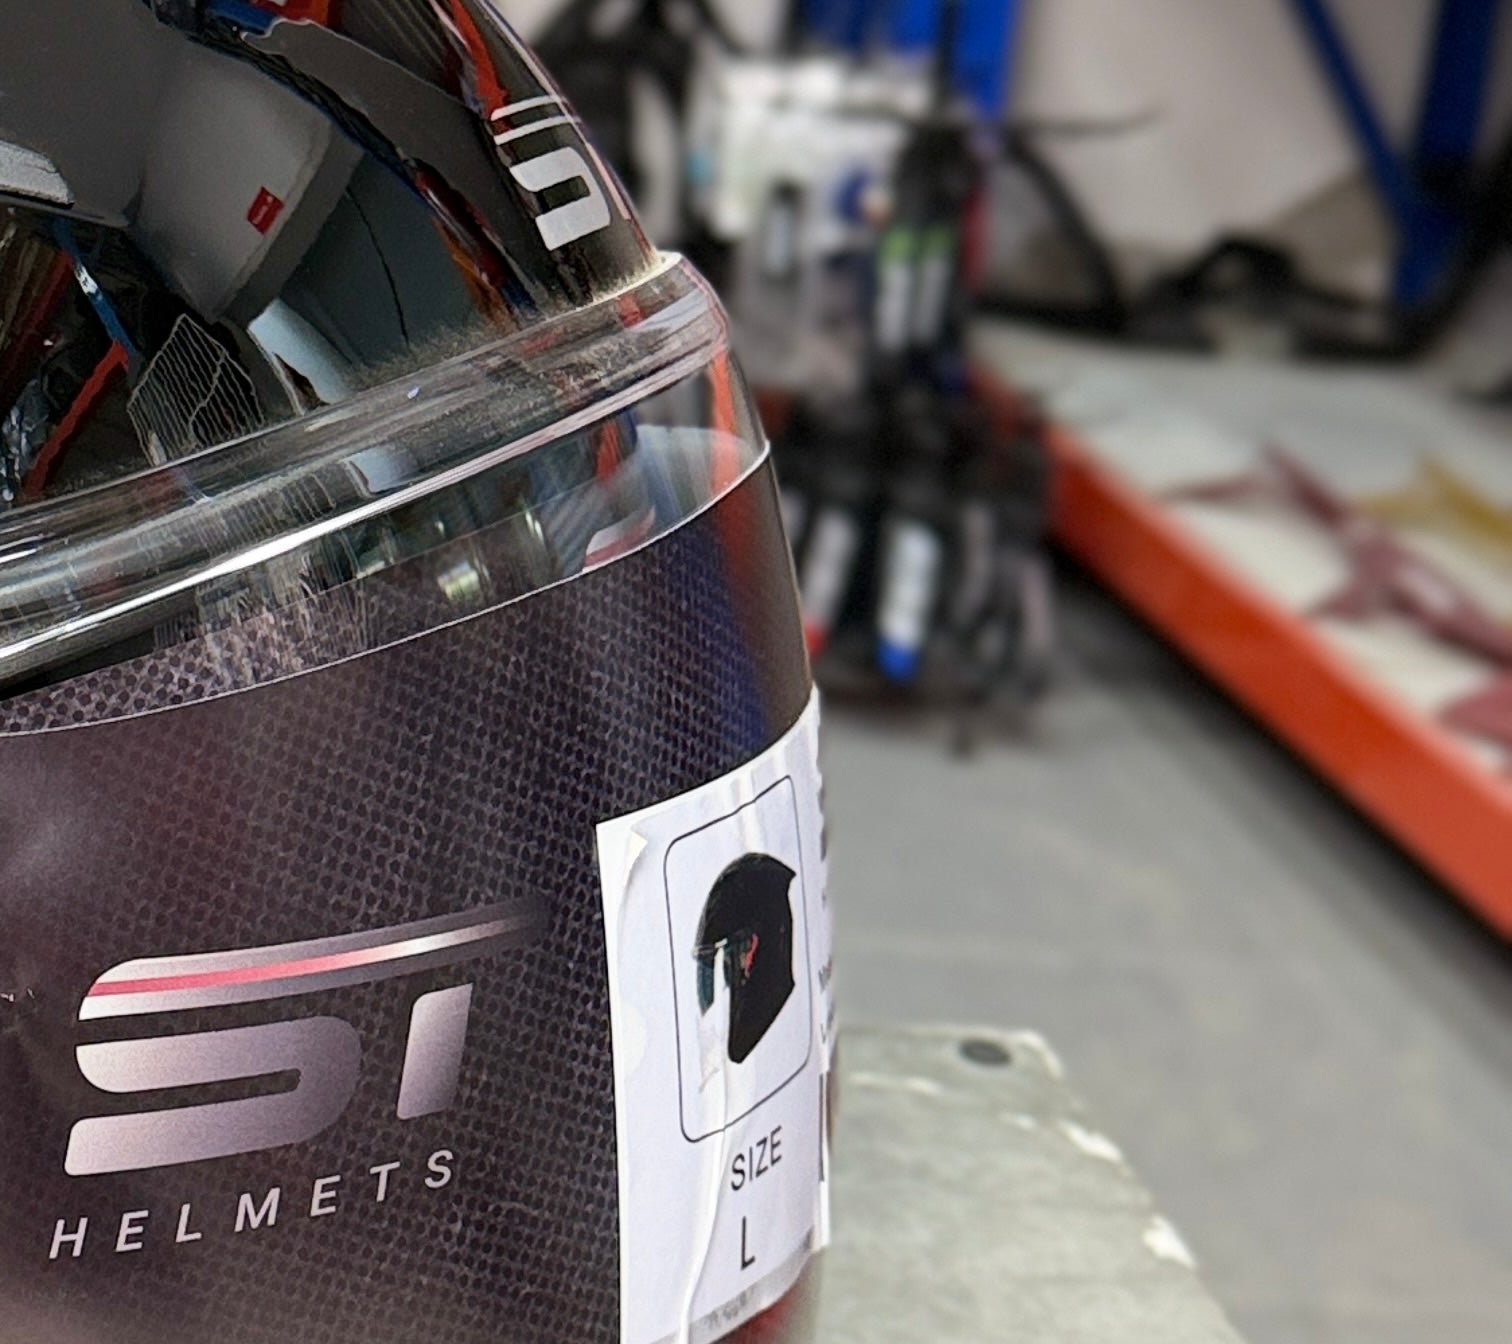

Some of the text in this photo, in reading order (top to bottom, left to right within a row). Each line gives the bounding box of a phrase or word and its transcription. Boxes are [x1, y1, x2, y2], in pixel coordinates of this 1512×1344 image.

[730, 1126, 783, 1193] SIZE
[48, 1149, 454, 1259] HELMETS
[740, 1215, 756, 1271] L
